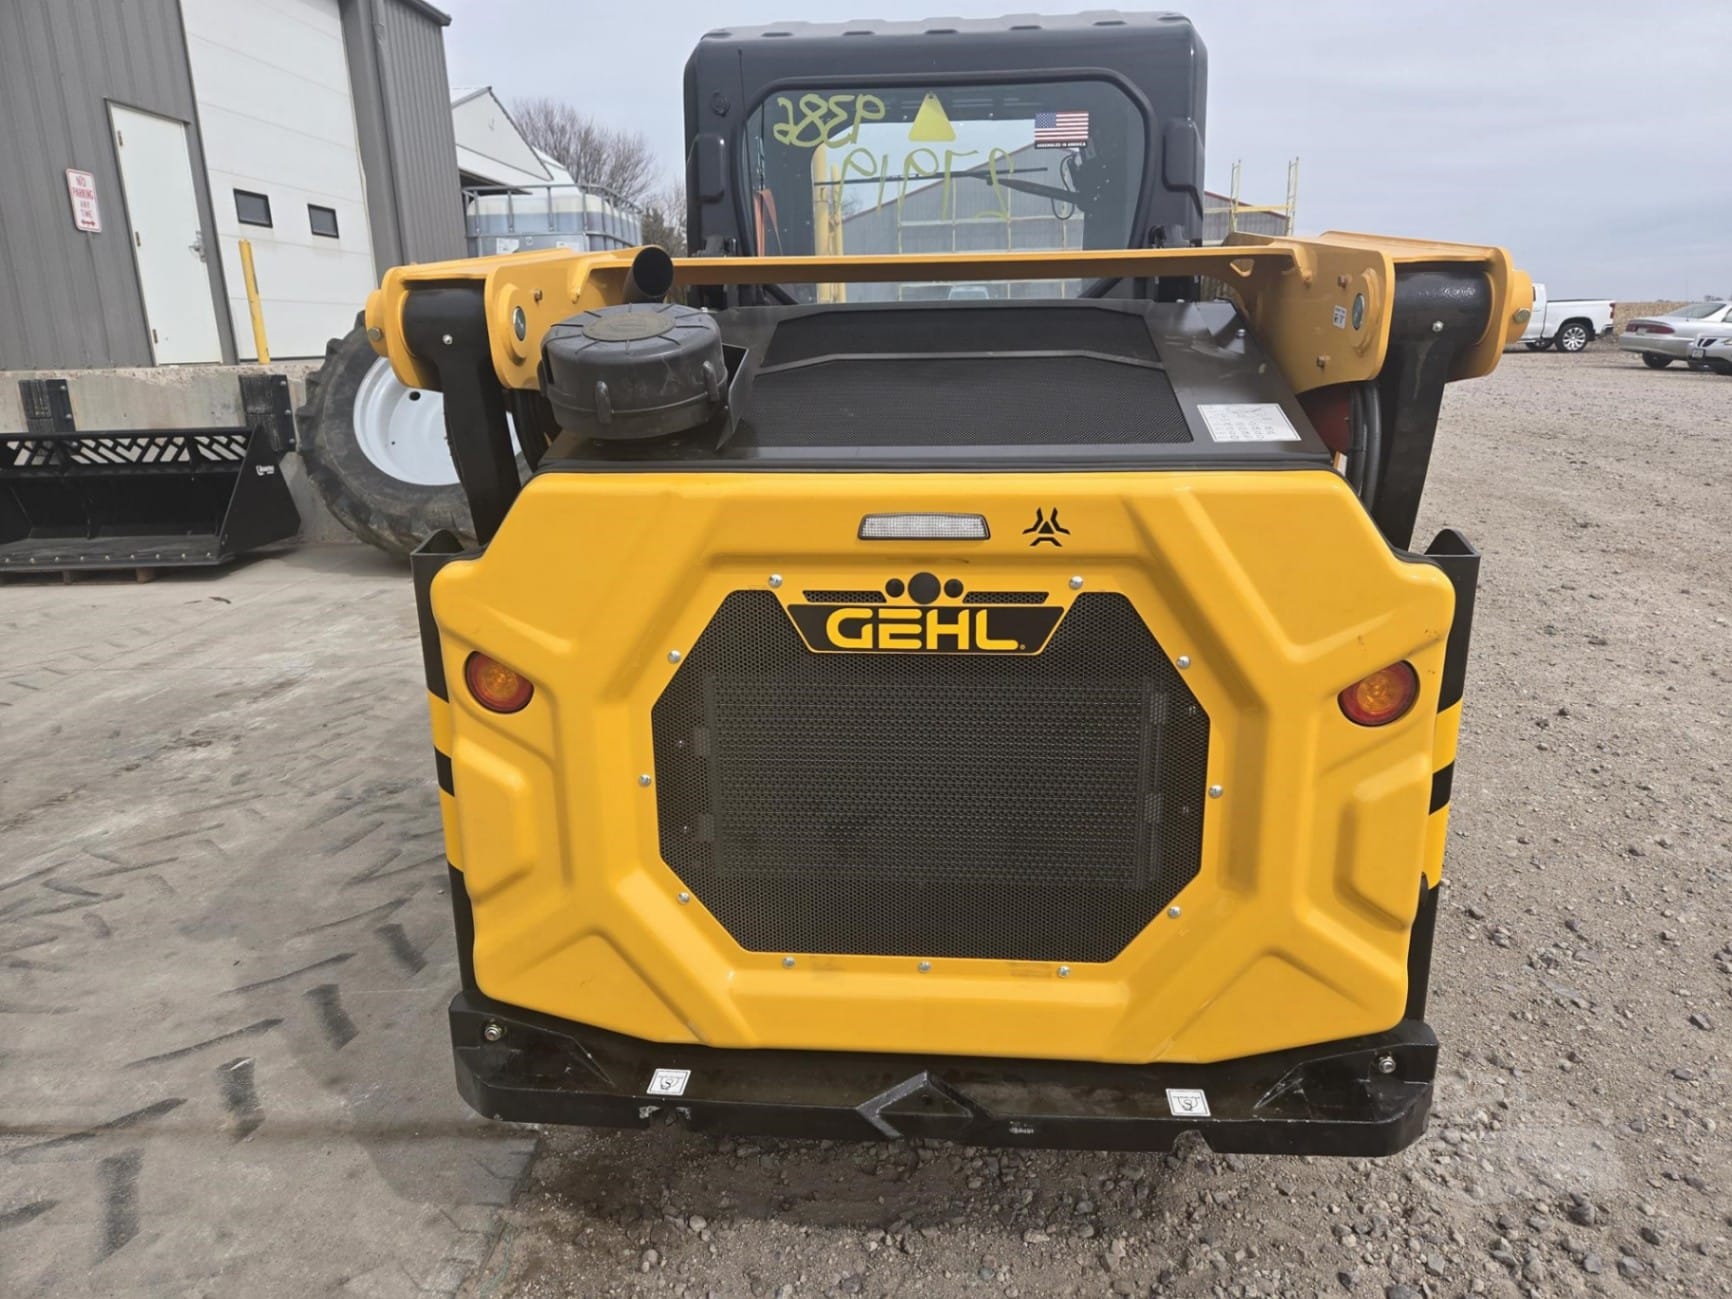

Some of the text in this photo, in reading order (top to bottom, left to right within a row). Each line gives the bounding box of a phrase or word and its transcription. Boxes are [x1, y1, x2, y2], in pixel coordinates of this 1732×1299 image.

[75, 175, 87, 187] NO
[72, 187, 96, 200] PARKING
[826, 607, 1019, 650] GEHL
